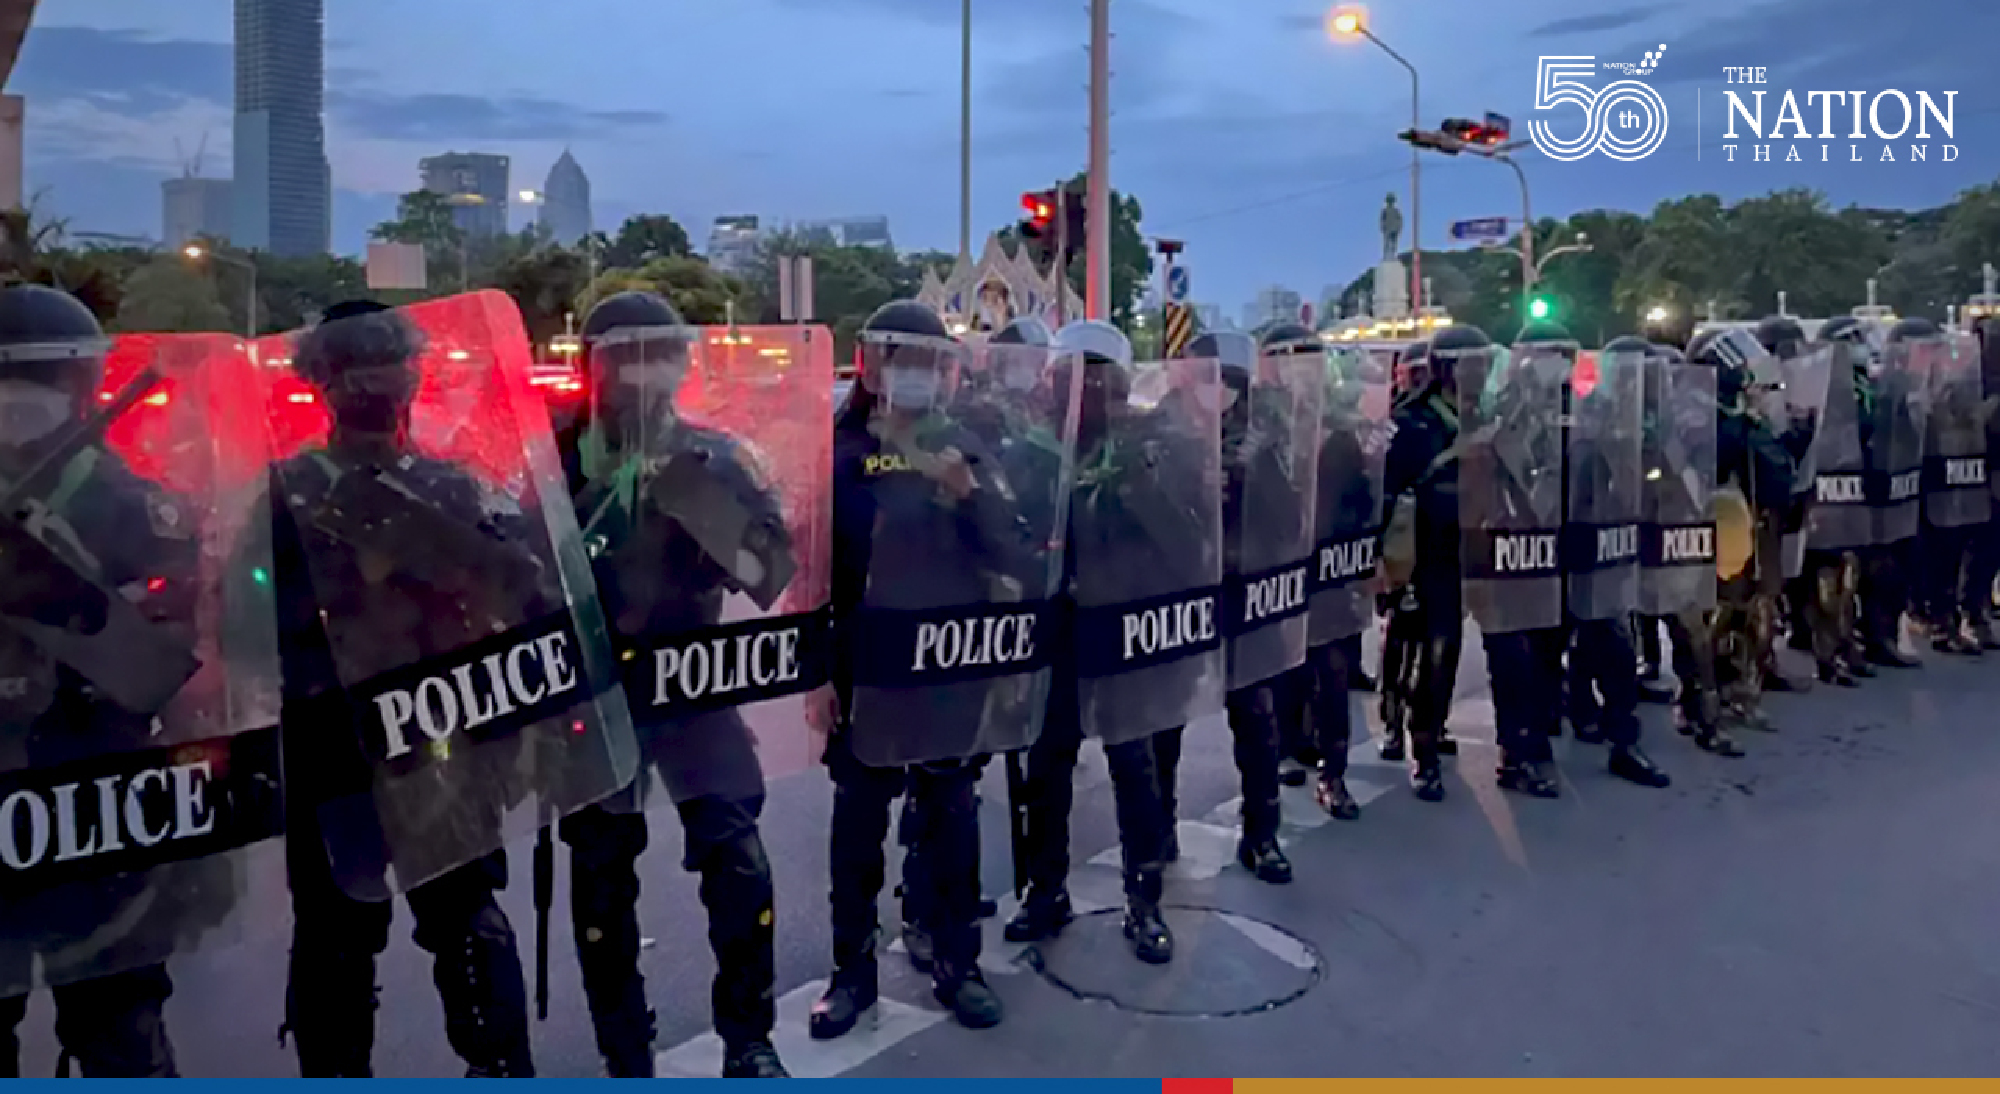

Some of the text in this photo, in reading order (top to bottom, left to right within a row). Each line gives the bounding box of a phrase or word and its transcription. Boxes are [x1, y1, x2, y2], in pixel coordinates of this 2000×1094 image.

[1319, 536, 1376, 580] POLICE
[1495, 535, 1556, 571] POLICE
[1244, 568, 1306, 621] POLICE
[912, 614, 1035, 670] POLICE
[1122, 598, 1215, 658] POLICE
[373, 631, 576, 759] POLICE
[652, 628, 799, 704] POLICE
[0, 761, 214, 869] OLICE
